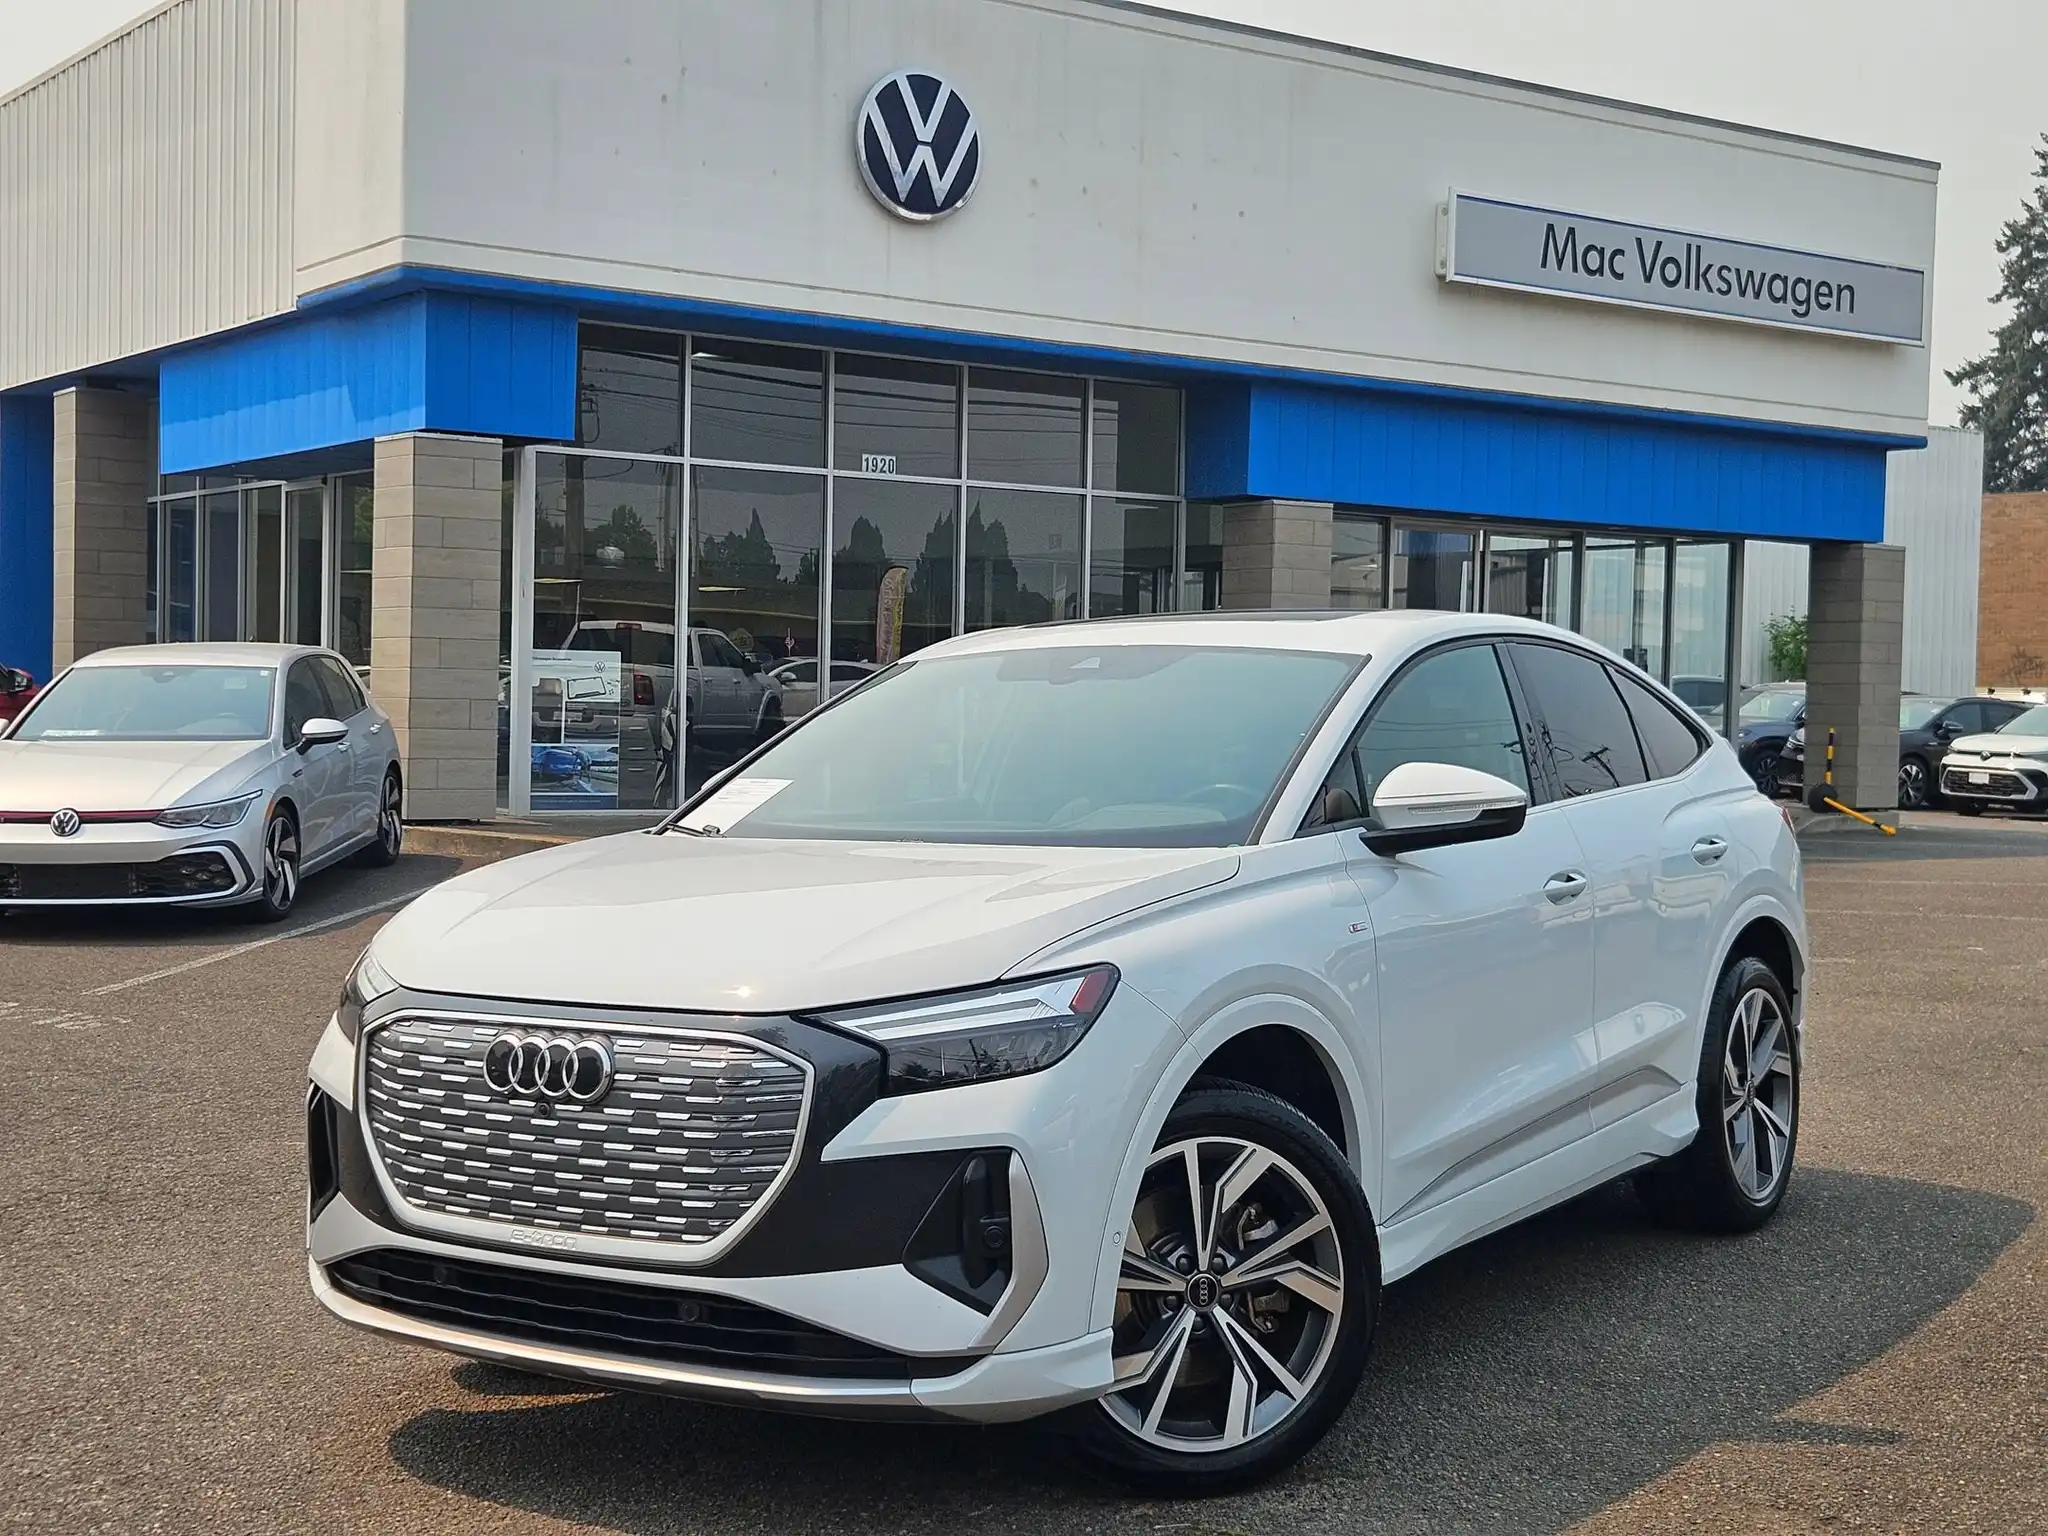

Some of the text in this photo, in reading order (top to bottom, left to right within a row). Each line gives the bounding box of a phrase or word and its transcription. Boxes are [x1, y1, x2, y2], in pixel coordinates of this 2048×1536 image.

[861, 71, 979, 211] VW
[1540, 222, 1856, 318] Mac Volkswagen
[864, 456, 895, 474] 1920
